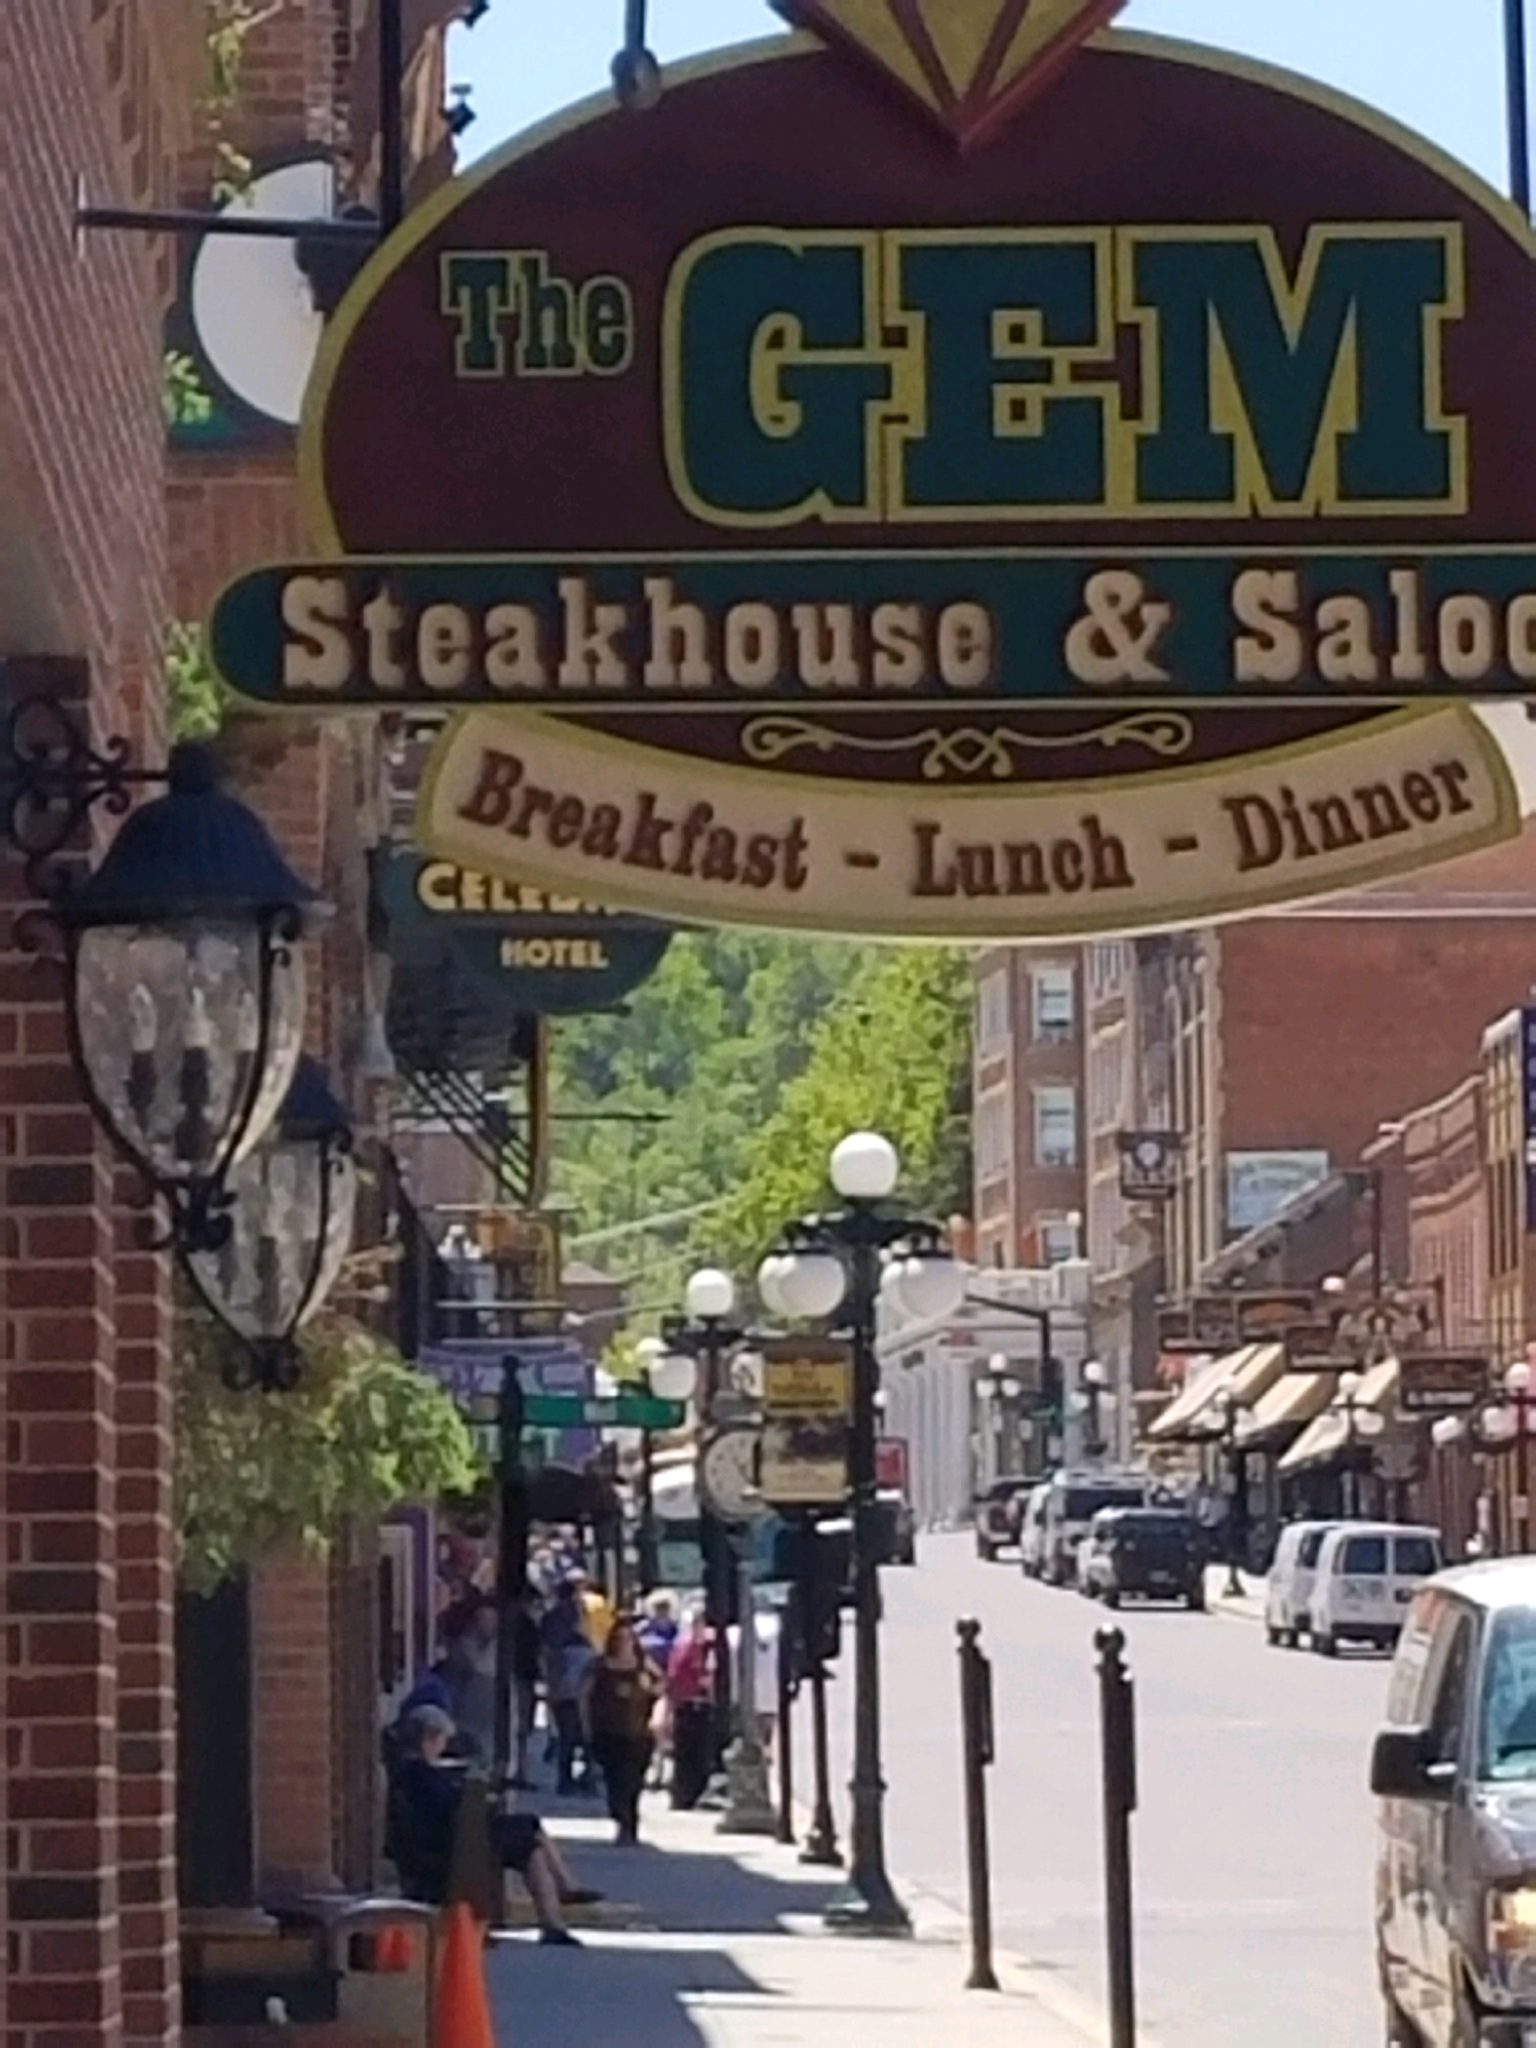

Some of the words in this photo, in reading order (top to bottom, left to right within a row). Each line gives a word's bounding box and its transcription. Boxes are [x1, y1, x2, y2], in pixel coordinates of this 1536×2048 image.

[440, 249, 635, 378] The
[660, 220, 1469, 529] GEM
[280, 574, 993, 691] Steakhouse
[1064, 569, 1171, 683] &
[457, 748, 810, 892] Breakfast
[911, 814, 1134, 898] Lunch
[1220, 757, 1475, 873] Dinner
[501, 937, 611, 969] HOTEL
